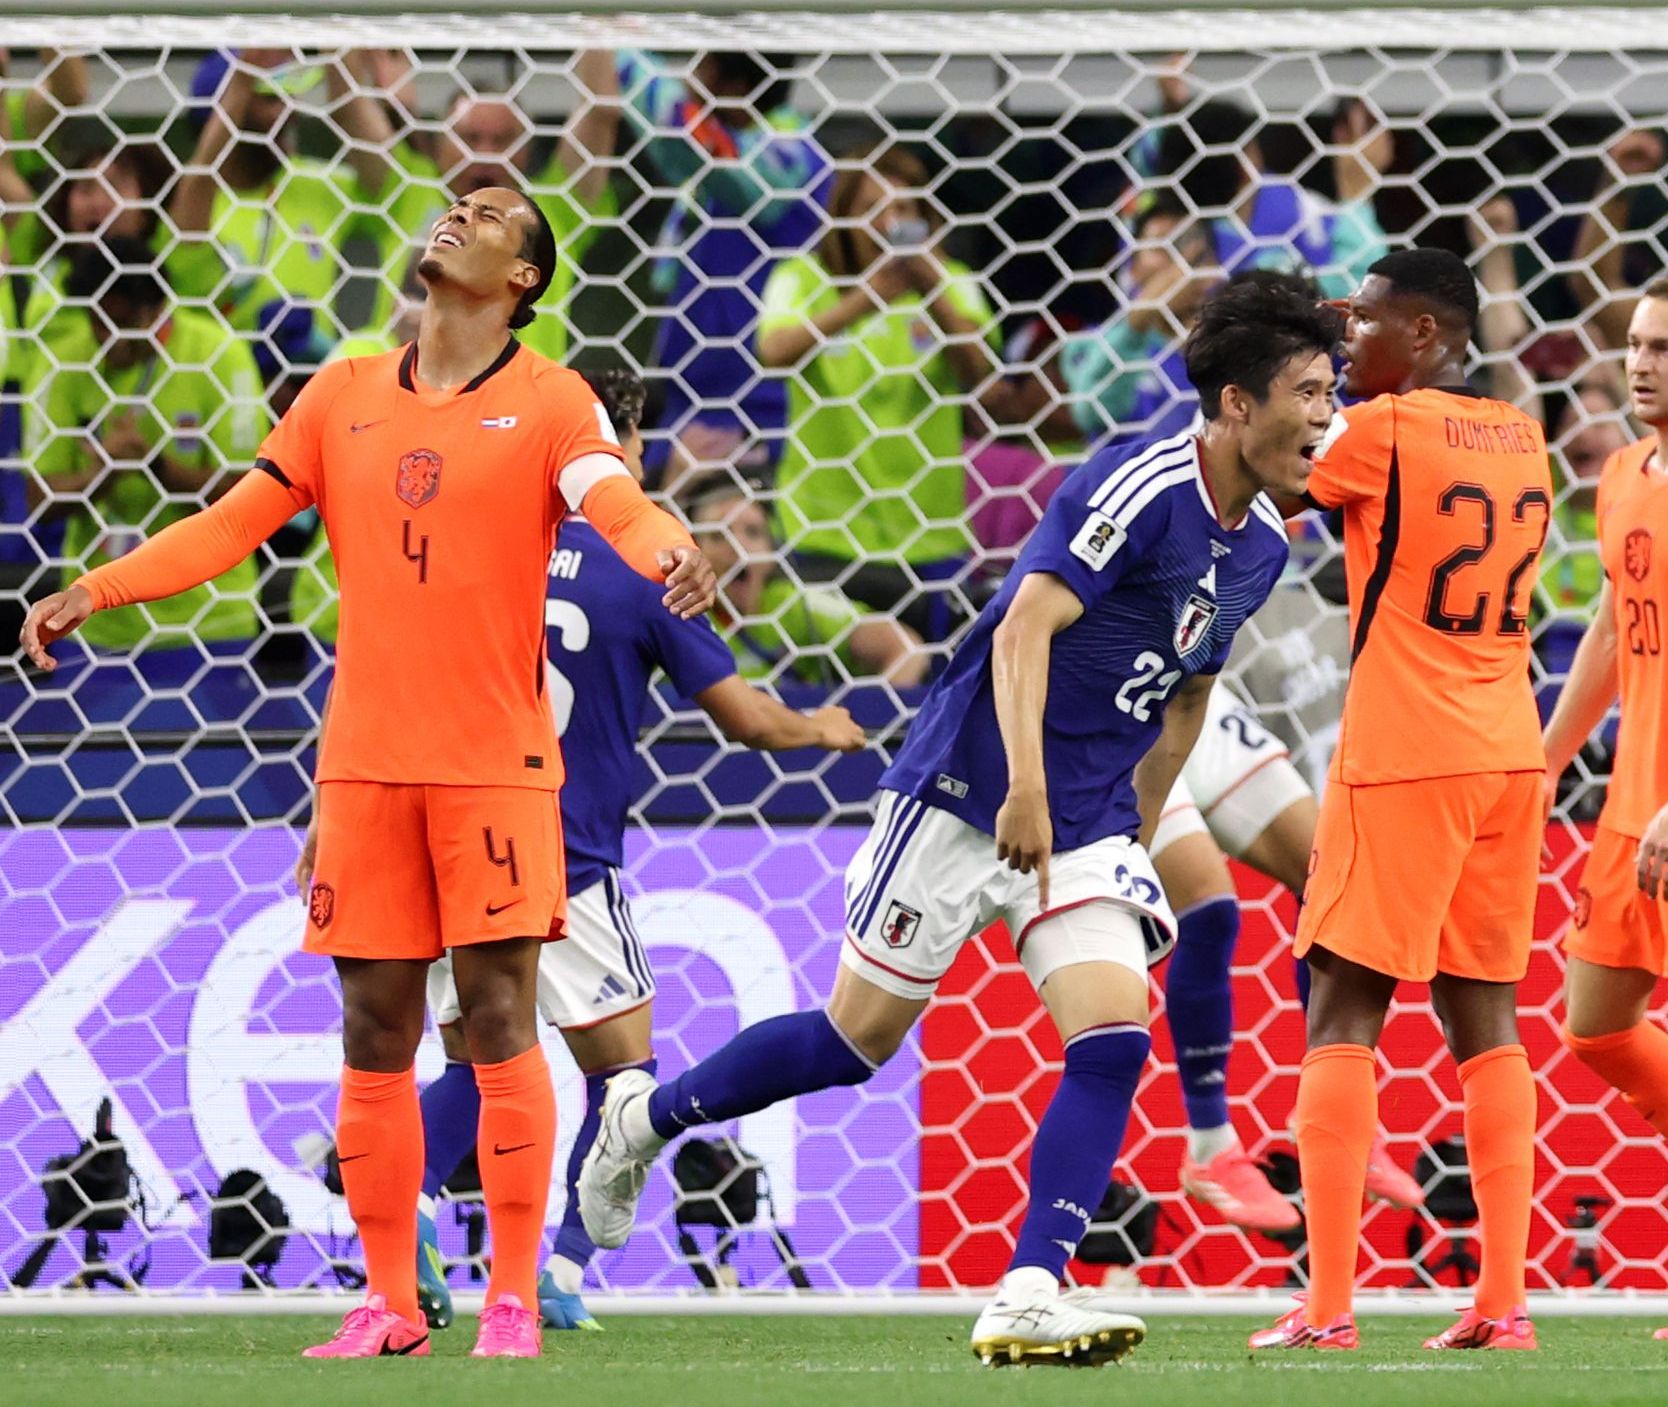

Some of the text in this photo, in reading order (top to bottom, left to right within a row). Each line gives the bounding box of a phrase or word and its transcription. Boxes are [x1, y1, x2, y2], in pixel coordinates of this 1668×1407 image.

[1444, 415, 1539, 455] DUMFRIES
[402, 518, 430, 585] 4
[1422, 480, 1552, 637] 22
[1625, 597, 1661, 657] 20
[1113, 650, 1183, 723] 22
[481, 824, 520, 887] 4
